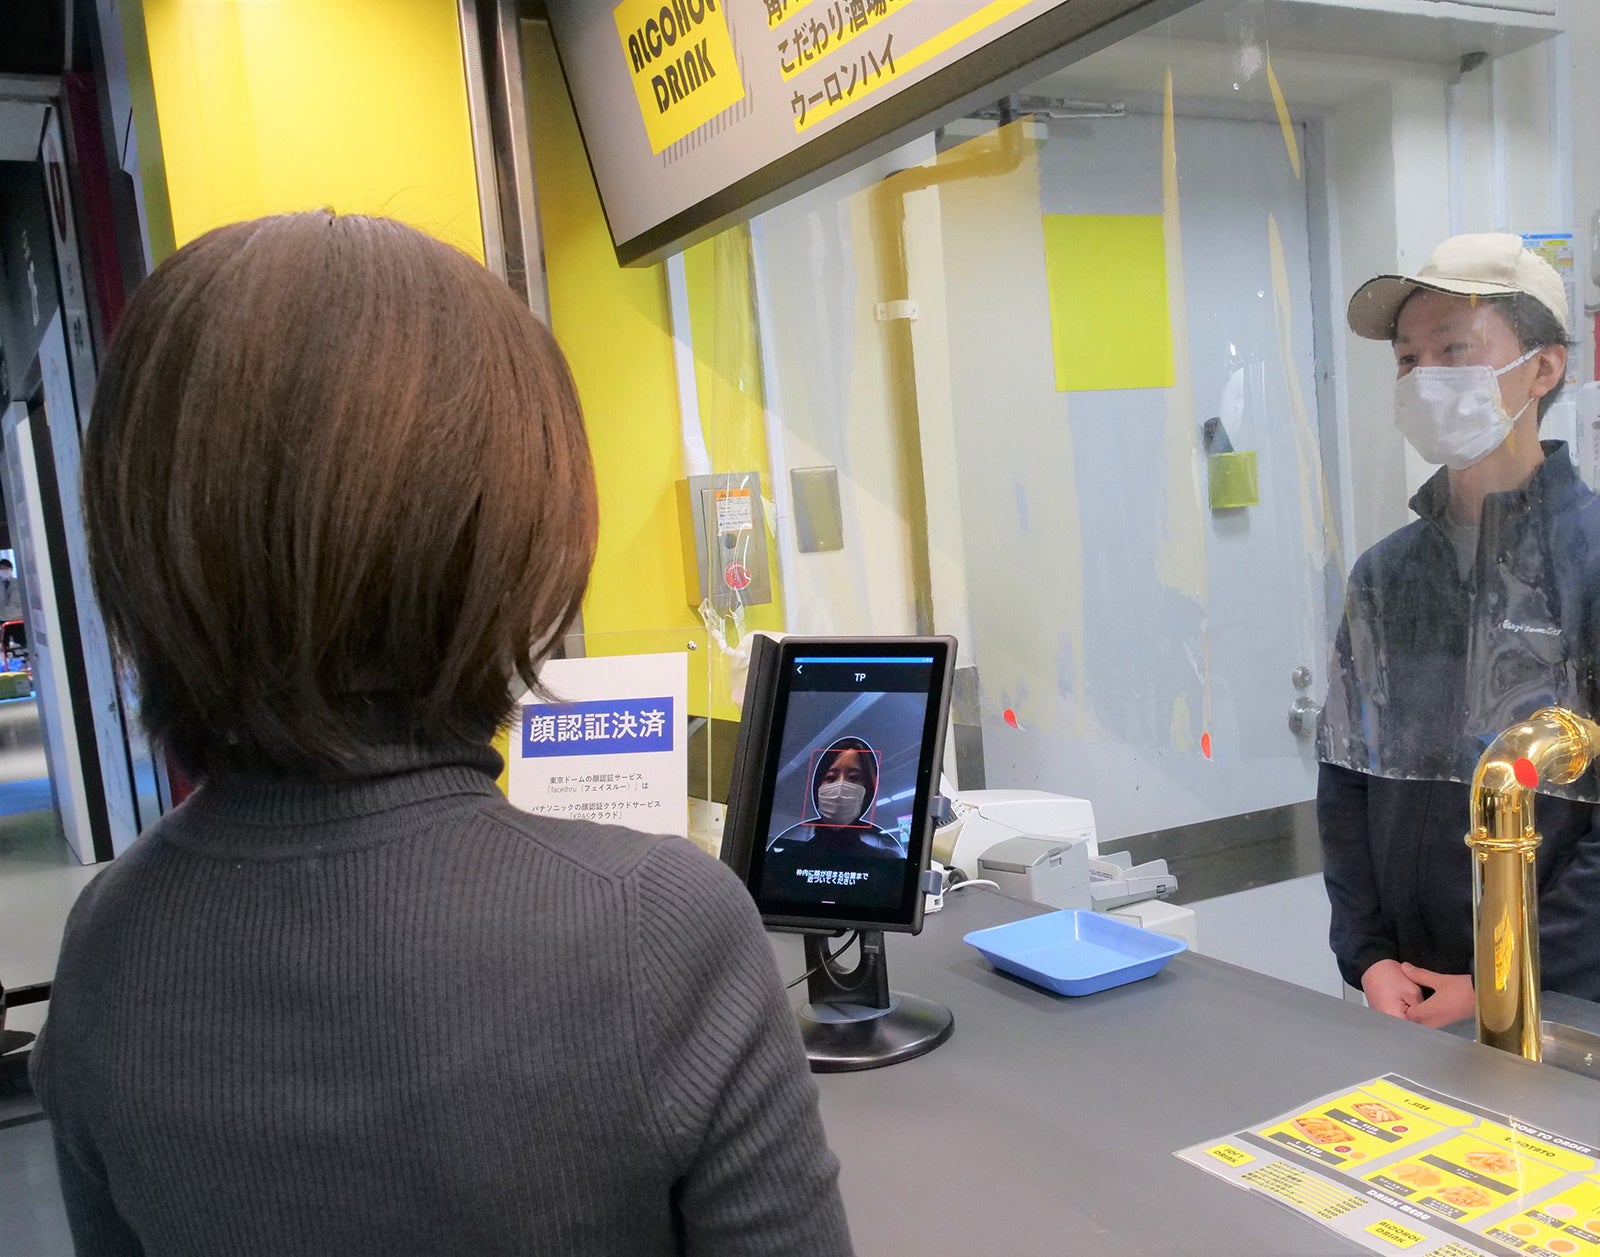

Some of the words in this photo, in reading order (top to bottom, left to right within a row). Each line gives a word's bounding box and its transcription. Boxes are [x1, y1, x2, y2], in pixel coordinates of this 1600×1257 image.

[777, 0, 902, 73] こだわり酒場
[651, 37, 716, 114] DRINK
[790, 33, 896, 125] ウーロンハイ
[854, 672, 866, 682] TP
[529, 709, 666, 743] 顔認証決済
[549, 773, 643, 785] 東京ドームの顔認証サービス
[1536, 1131, 1553, 1140] TO
[1552, 1138, 1591, 1153] ORDER
[1366, 1189, 1402, 1208] DRINK
[1399, 1205, 1432, 1220] MENU
[1375, 1227, 1404, 1243] DRINK
[1379, 1221, 1421, 1242] ALCOHOL
